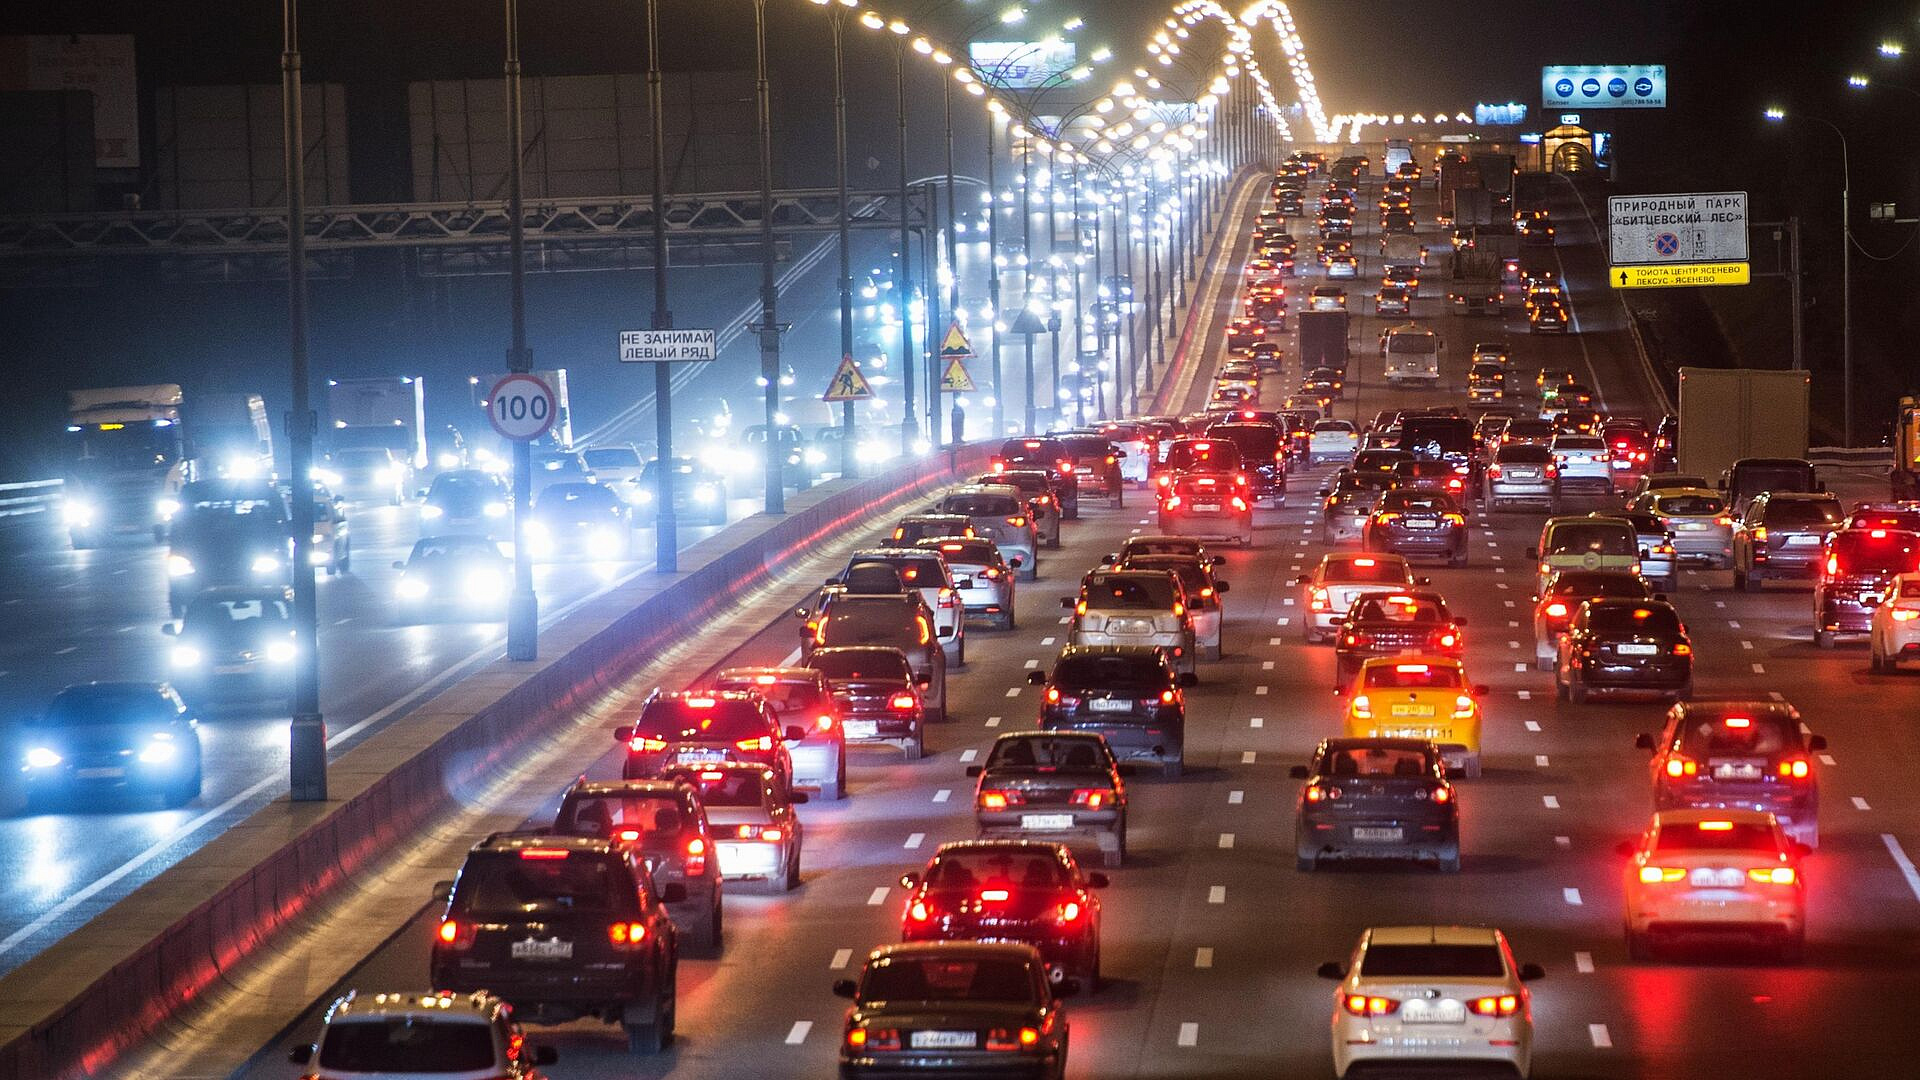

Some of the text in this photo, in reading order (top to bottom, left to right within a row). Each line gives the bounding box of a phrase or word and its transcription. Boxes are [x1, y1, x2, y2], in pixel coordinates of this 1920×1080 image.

[1614, 198, 1741, 212] ПРИРОДНЫЙ ПАРК
[1614, 211, 1743, 226] «БИТЦЕВСКИЙ ЛЕС»
[1671, 267, 1698, 276] ЦЕНТР
[1700, 266, 1740, 274] ЯСЕНЕВО
[1636, 277, 1669, 285] ЛЕКСУС
[1675, 276, 1715, 284] ЯСЕНЕВО
[621, 330, 713, 345] НЕ ЗАНИМАЙ
[625, 345, 710, 360] ЛЕВЫЙ РЯД
[497, 395, 547, 420] 100
